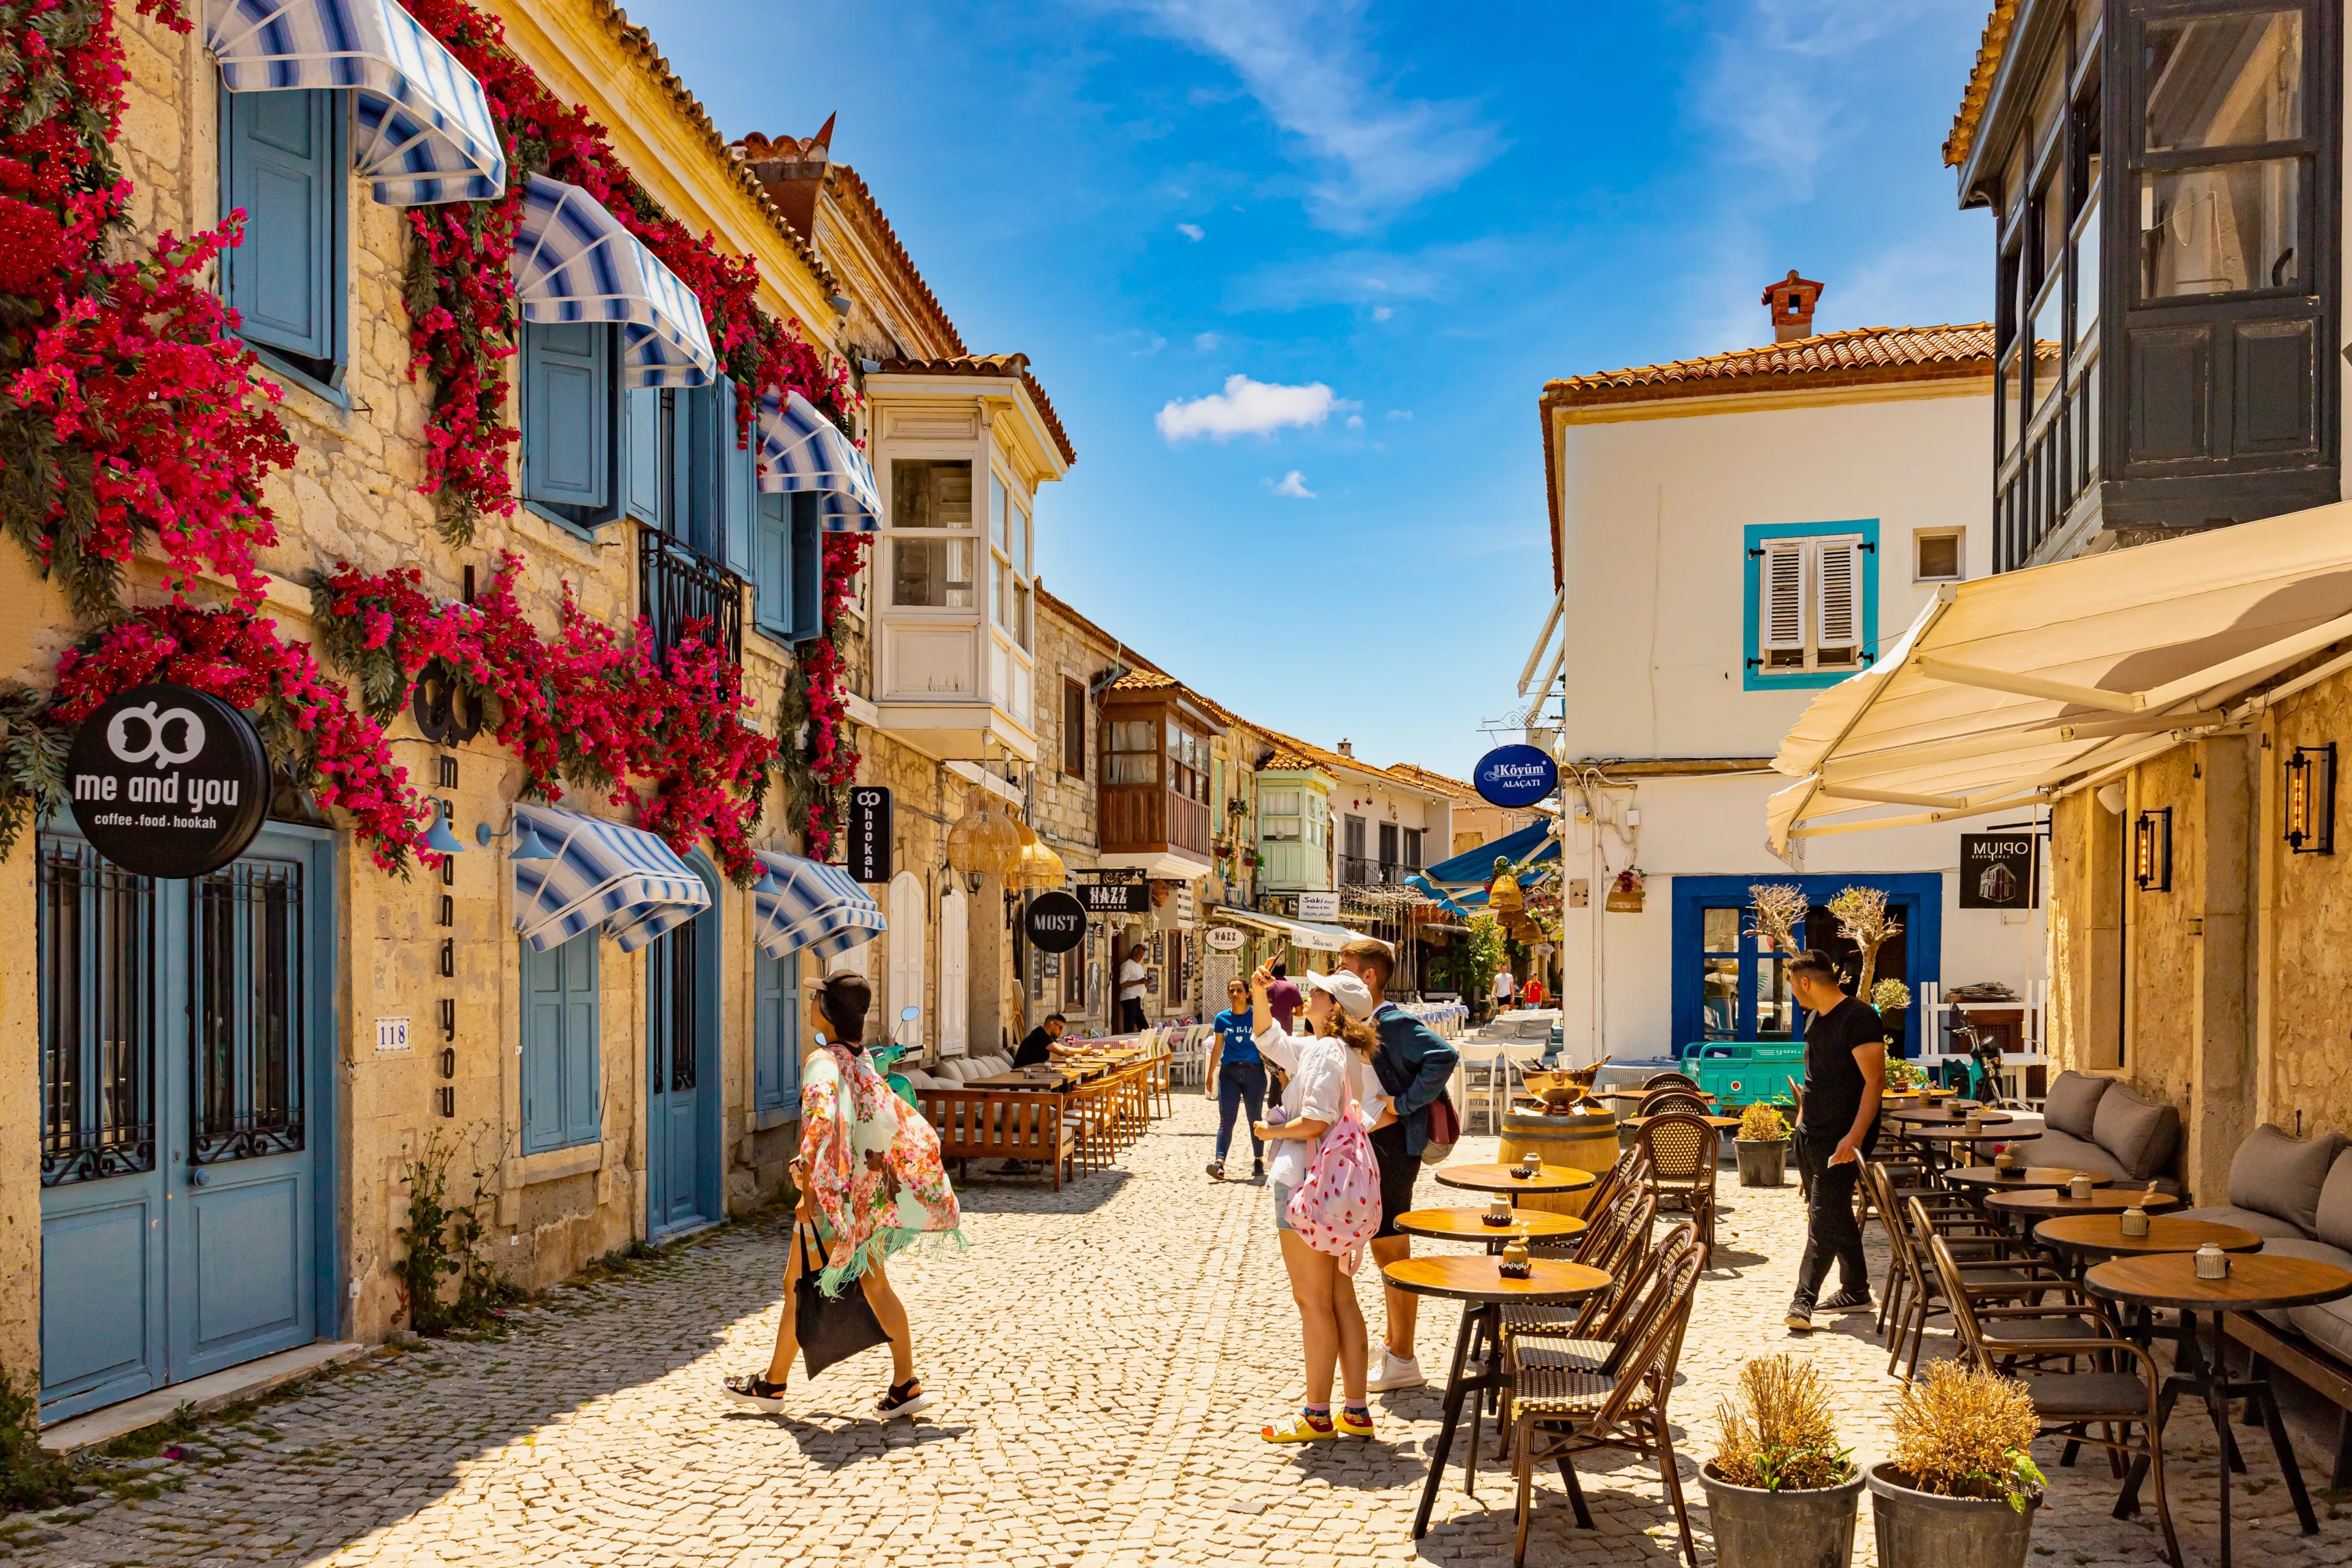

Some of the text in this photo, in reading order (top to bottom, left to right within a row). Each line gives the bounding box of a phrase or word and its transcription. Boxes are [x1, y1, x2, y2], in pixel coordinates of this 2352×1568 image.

[1500, 763, 1544, 779] Köyüm
[75, 771, 239, 813] me and you
[1502, 779, 1540, 788] ALAÇATI
[94, 813, 132, 826] coffee
[173, 815, 216, 829] hookah
[864, 808, 873, 879] hookah
[1090, 887, 1128, 904] HAZZ
[1034, 914, 1078, 932] MOST
[1215, 931, 1236, 941] HAZZ
[1295, 982, 1309, 992] AZZ
[380, 1025, 405, 1045] 118
[442, 998, 454, 1118] you
